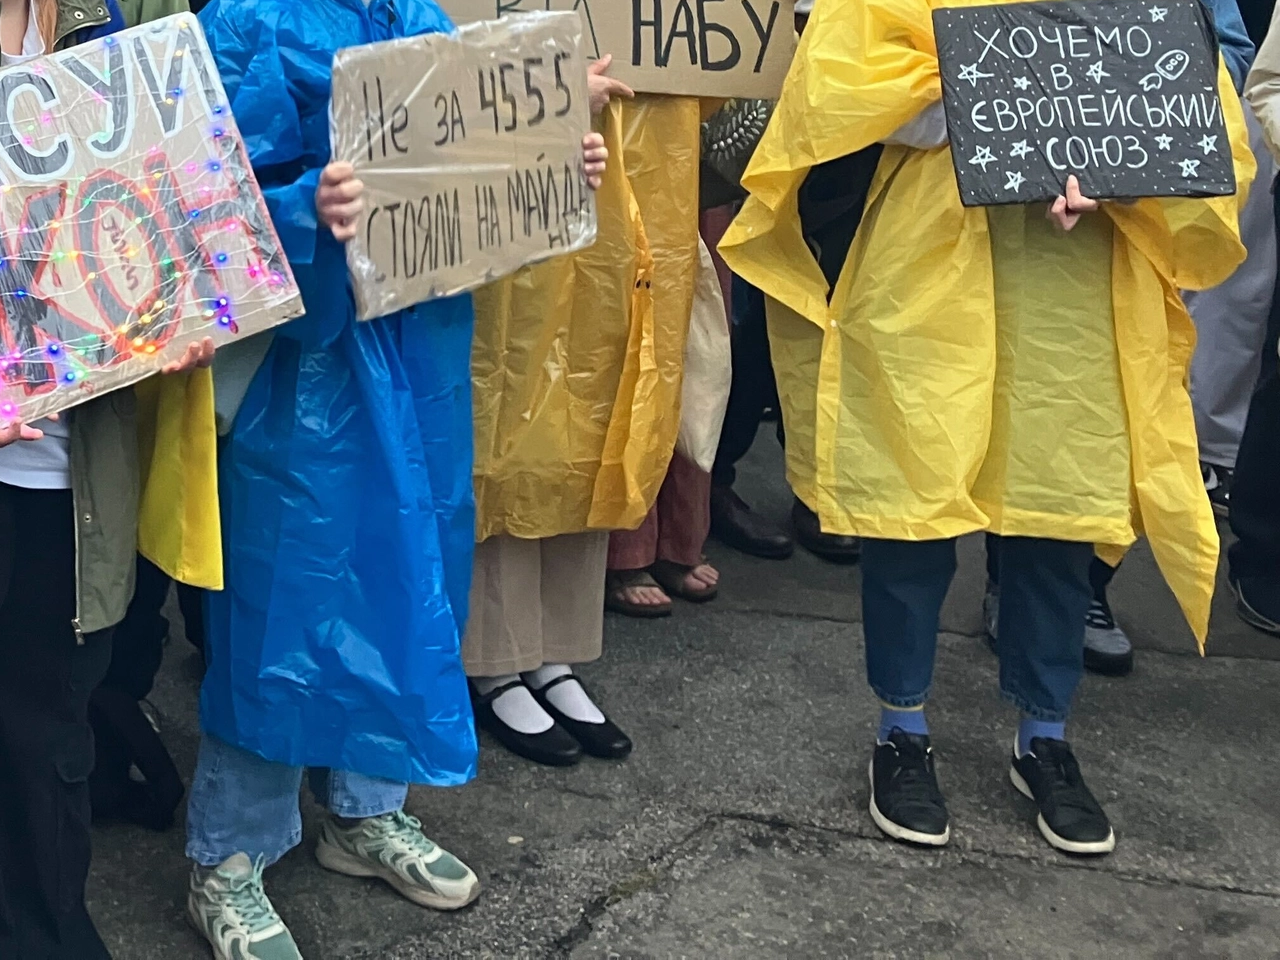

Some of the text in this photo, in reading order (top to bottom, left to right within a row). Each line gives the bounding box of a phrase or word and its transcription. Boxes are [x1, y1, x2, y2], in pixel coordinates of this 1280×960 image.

[973, 25, 1152, 64] ХОЧЕМО
[1050, 62, 1073, 90] В
[433, 89, 467, 147] ЗА
[971, 85, 1225, 132] ЄВРОПЕЙСЬКИЙ
[1045, 134, 1149, 170] СОЮЗ
[365, 188, 463, 283] СТОЯЛИ
[474, 183, 502, 252] НА
